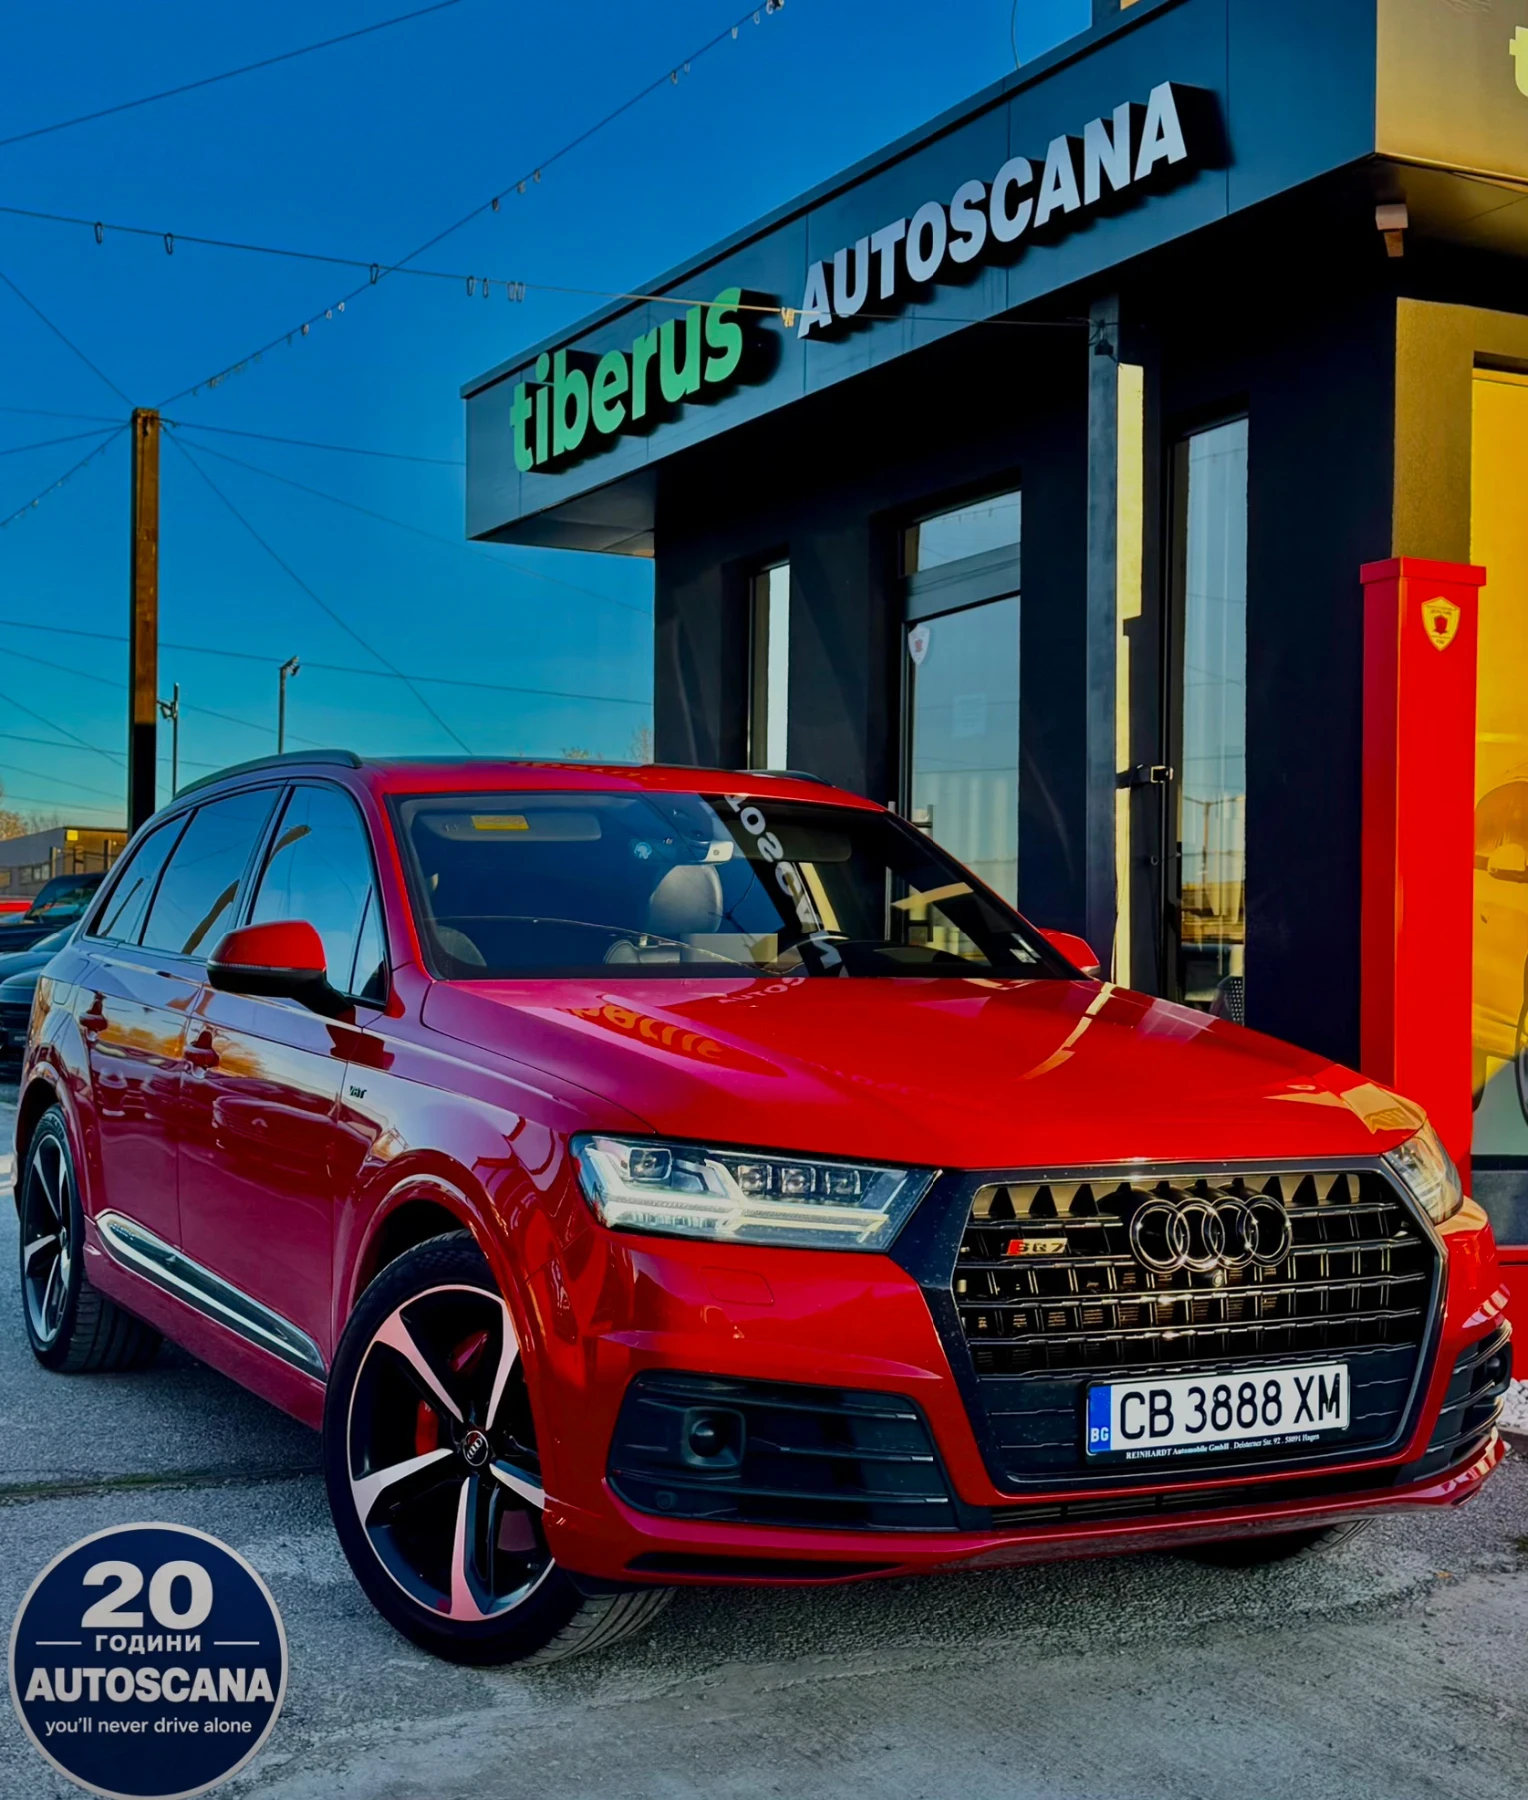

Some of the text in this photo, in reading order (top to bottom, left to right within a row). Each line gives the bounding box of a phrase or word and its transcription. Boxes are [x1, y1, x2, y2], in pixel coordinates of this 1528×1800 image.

[509, 82, 1187, 473] tiberus AUTOSCANA
[1120, 1372, 1341, 1440] CB 3888 XM
[1090, 1426, 1109, 1443] BG
[1126, 1448, 1173, 1459] REINHARDT
[1172, 1445, 1208, 1455] Automobile
[1208, 1442, 1230, 1452] GmbH
[1302, 1433, 1320, 1443] Hagen
